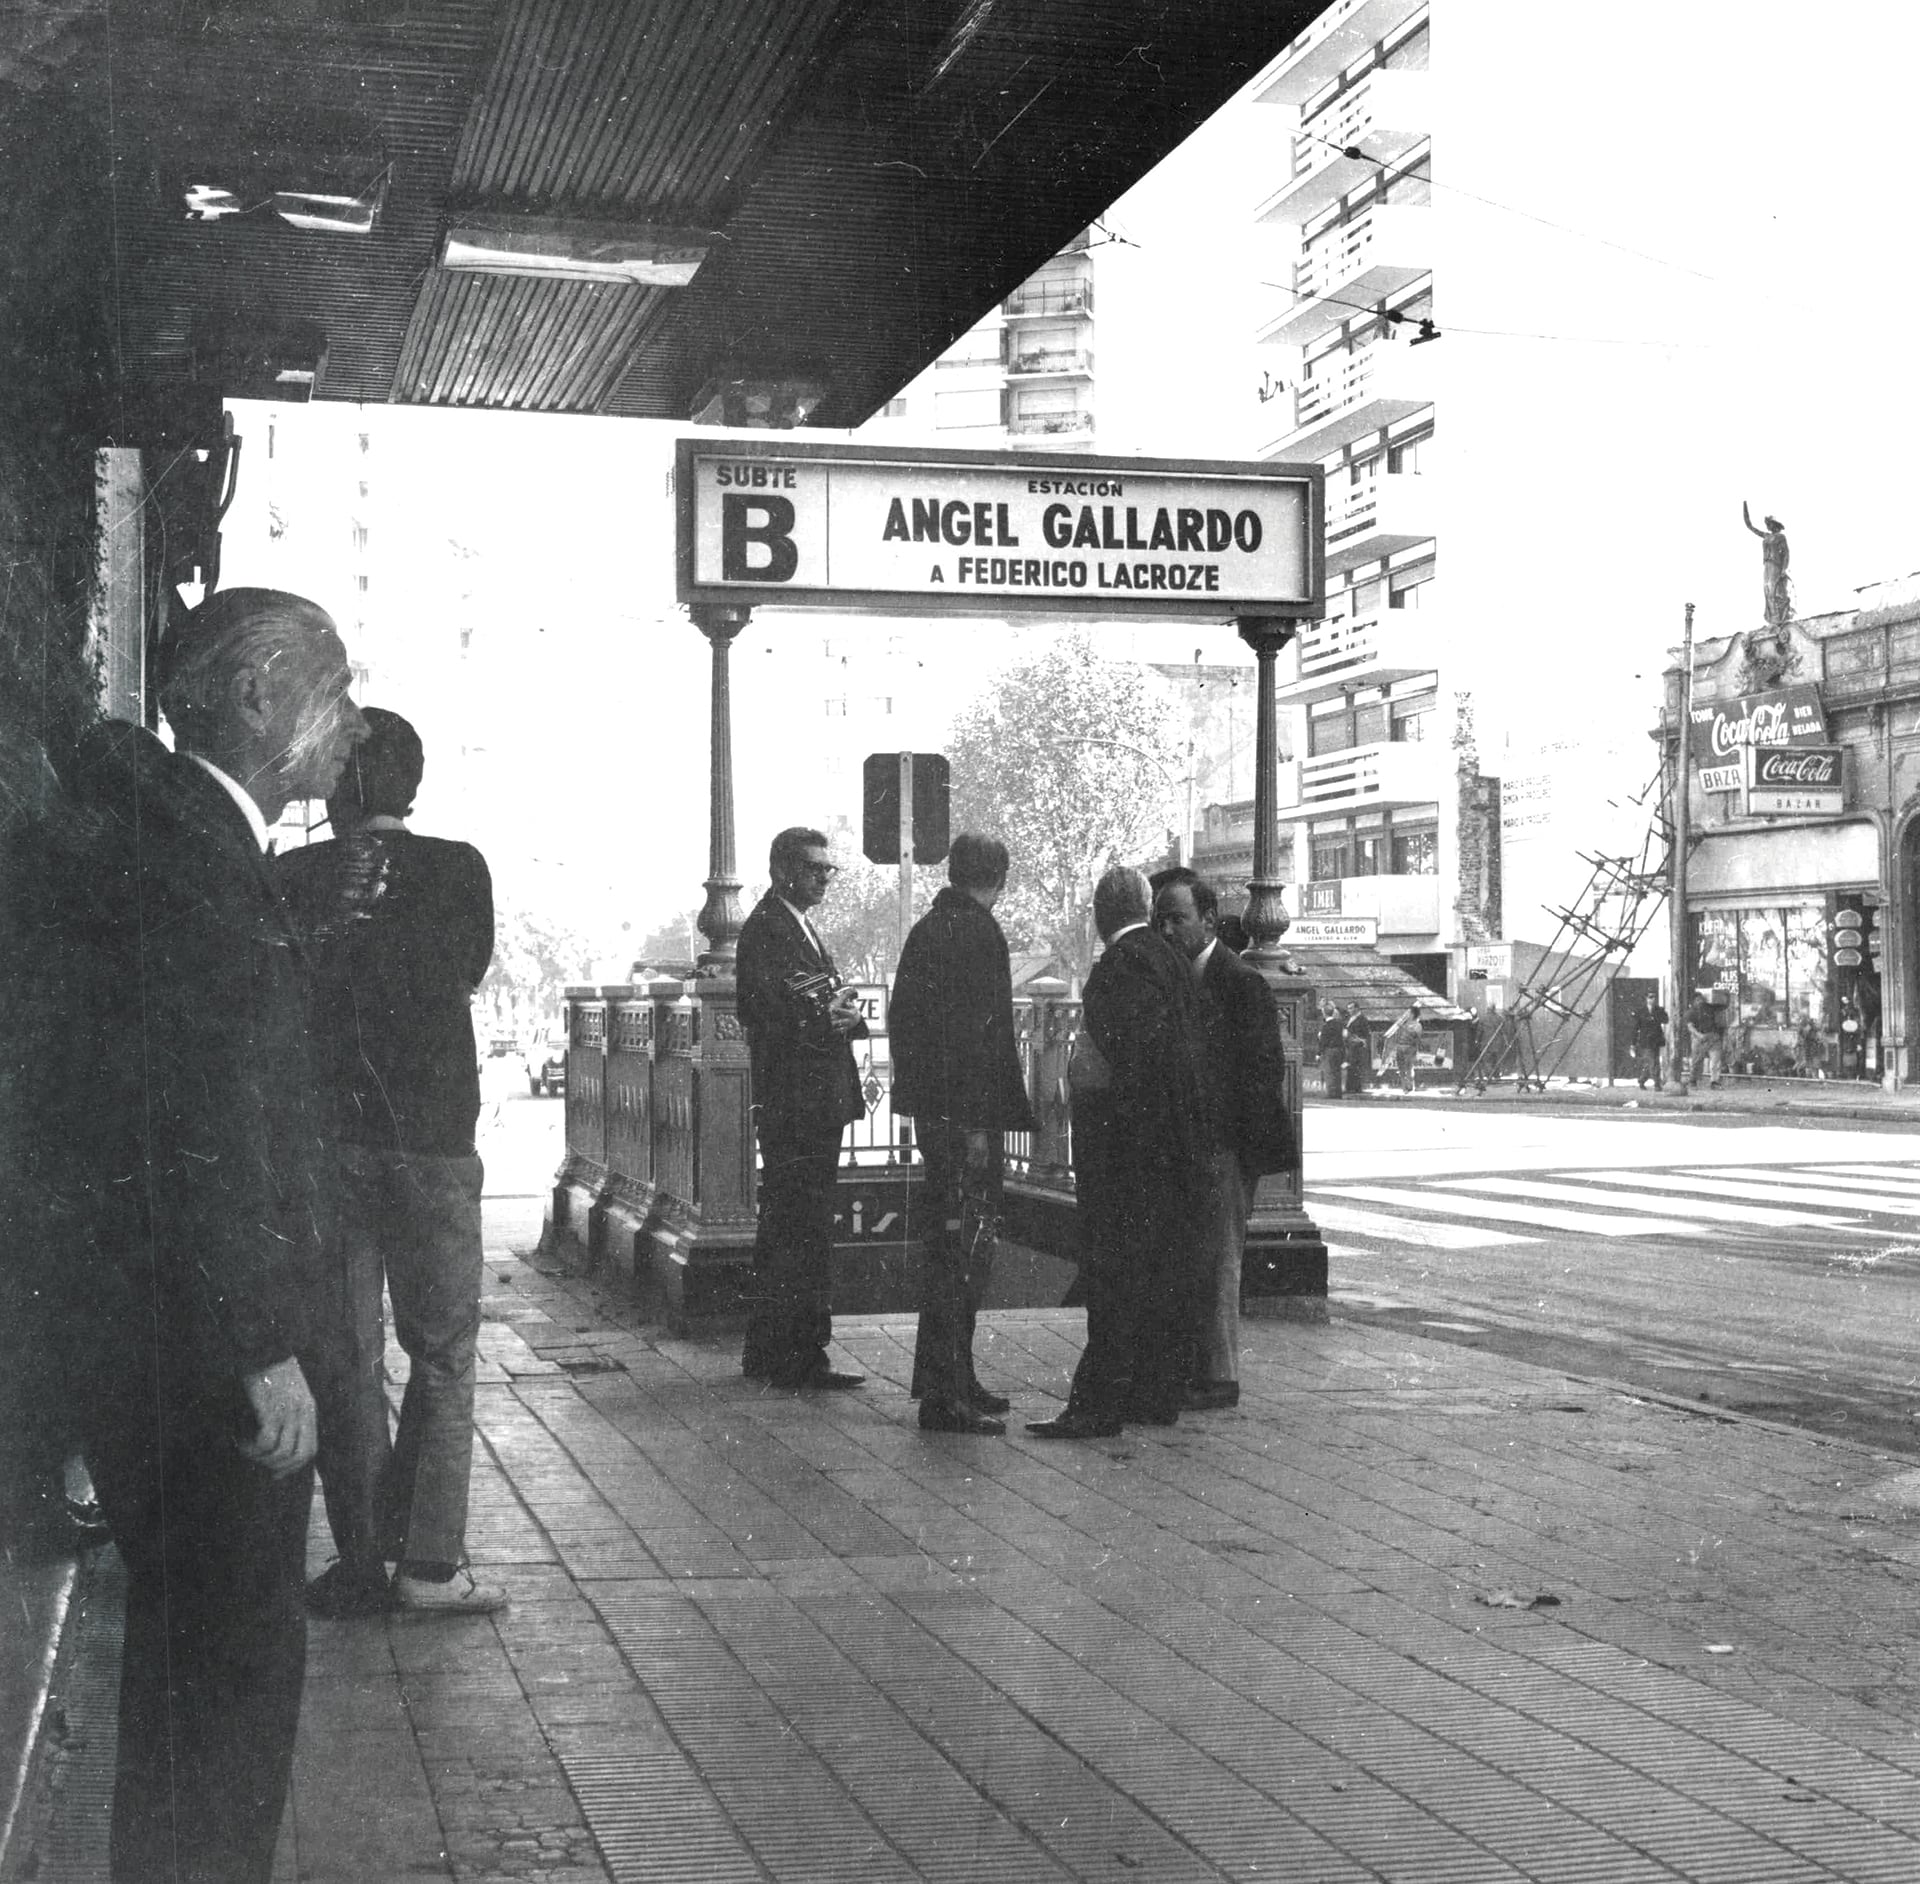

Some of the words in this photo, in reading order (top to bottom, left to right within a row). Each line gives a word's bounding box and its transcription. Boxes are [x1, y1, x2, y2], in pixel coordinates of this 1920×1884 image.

[717, 464, 797, 489] SUBTE
[722, 493, 798, 583] B
[884, 497, 1019, 548] ANGEL
[1042, 502, 1263, 554] GALLARDO
[931, 565, 944, 583] A
[959, 557, 1088, 589] FEDERICO
[1098, 562, 1219, 591] LACROZE
[1703, 768, 1741, 789] BAZA
[1776, 798, 1821, 809] BAZAR
[1295, 925, 1320, 935] ANGEL
[1324, 925, 1366, 935] GALLARDO
